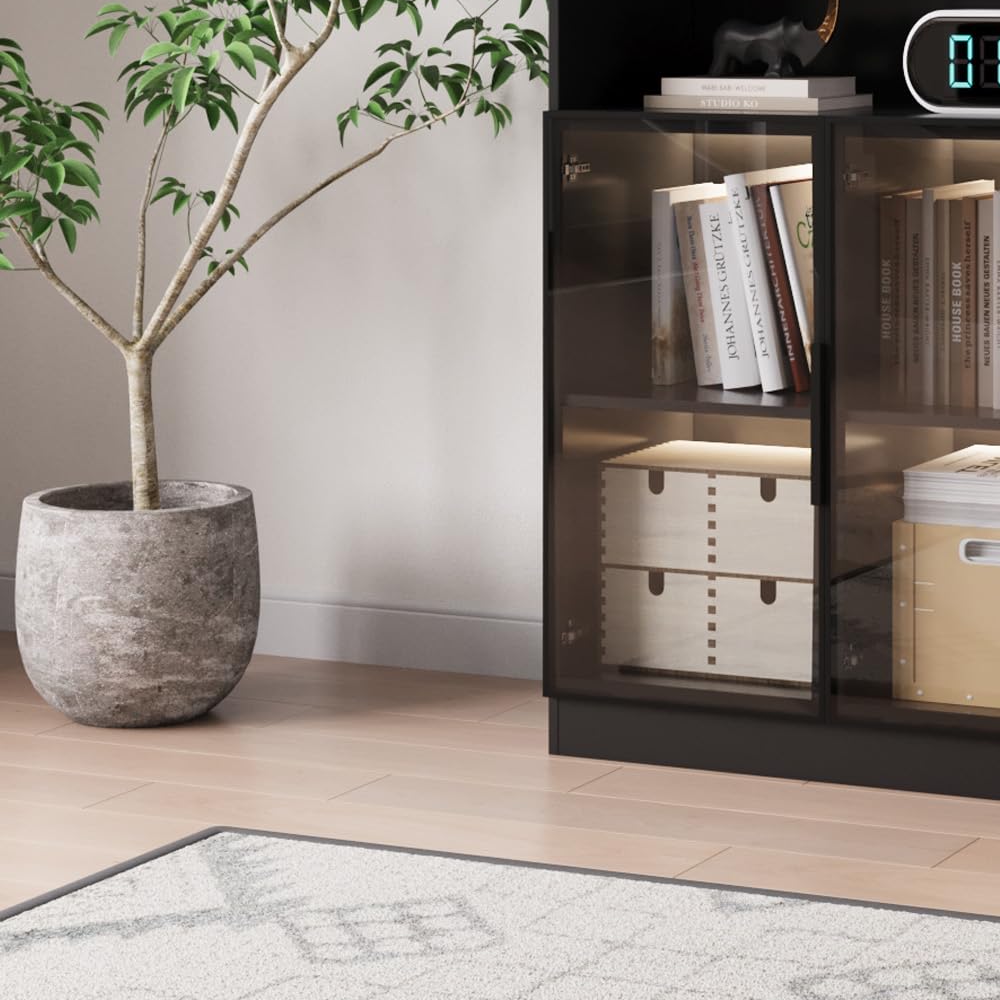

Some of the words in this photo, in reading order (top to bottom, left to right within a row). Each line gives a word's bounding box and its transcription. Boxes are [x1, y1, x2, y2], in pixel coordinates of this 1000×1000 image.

[701, 99, 740, 108] STUDIO
[983, 235, 991, 279] GESTALTEN
[881, 258, 890, 294] BOOK
[951, 261, 962, 297] BOOK
[983, 281, 991, 309] NEUES
[718, 284, 740, 360] JOHANNES
[745, 270, 770, 359] JOHANNES
[881, 297, 891, 340] HOUSE
[952, 300, 962, 343] HOUSE
[983, 310, 991, 338] BAUEN
[983, 339, 991, 367] NEUES
